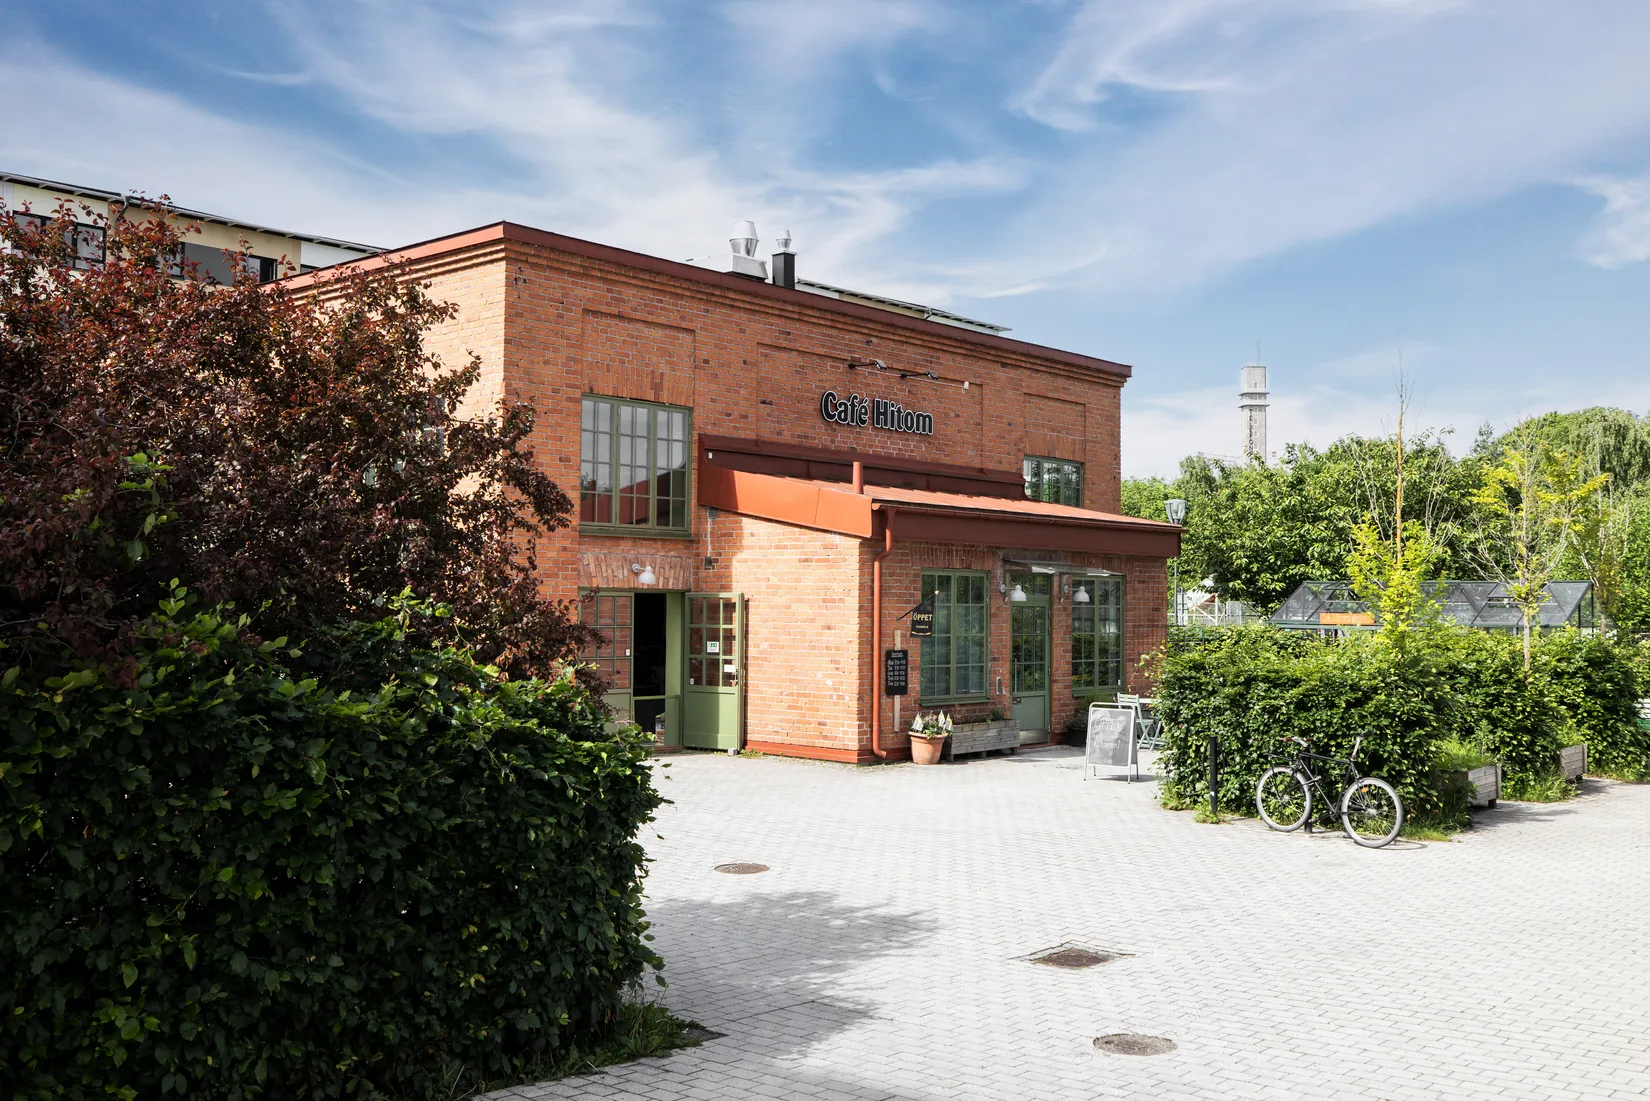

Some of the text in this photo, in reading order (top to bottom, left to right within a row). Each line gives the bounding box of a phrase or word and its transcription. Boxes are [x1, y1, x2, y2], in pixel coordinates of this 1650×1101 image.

[821, 391, 933, 435] Café Hitom
[912, 612, 933, 621] ÖPPET
